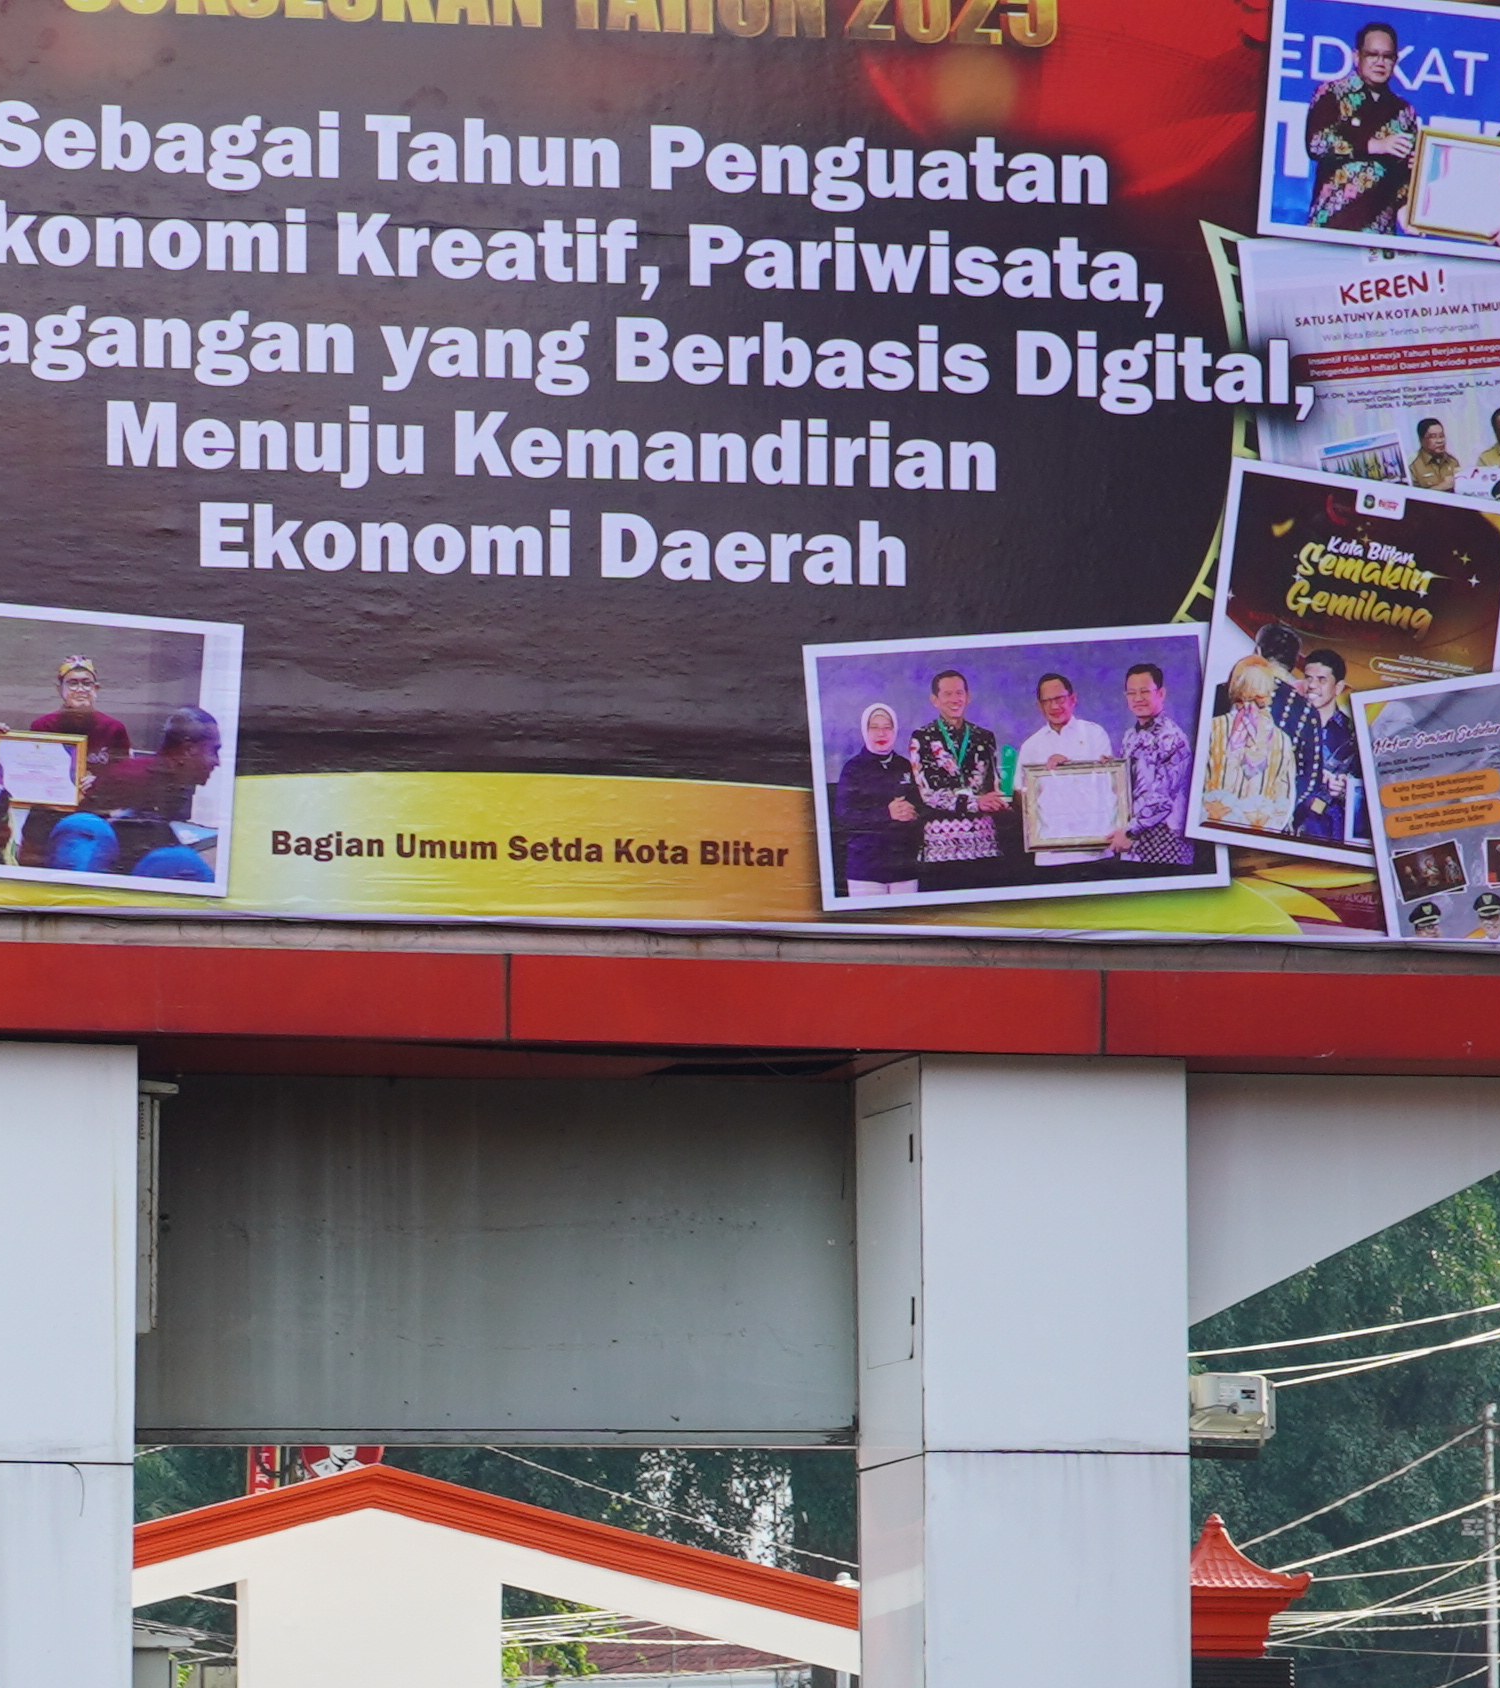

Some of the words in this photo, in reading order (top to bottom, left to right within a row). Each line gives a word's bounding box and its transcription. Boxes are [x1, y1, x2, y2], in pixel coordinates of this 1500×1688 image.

[1281, 33, 1489, 96] EDKAT
[365, 114, 620, 188] Tahun
[650, 124, 1108, 213] Penguatan
[337, 211, 659, 301] Kreatif,
[688, 224, 1164, 319] Pariwisata,
[1340, 270, 1428, 306] KEREN
[1295, 316, 1325, 327] SATU
[1328, 312, 1383, 325] SATUNYA
[1385, 308, 1420, 320] KOTA
[1421, 307, 1432, 316] DI
[1435, 304, 1469, 316] JAWA
[1344, 331, 1363, 341] Kota
[1365, 329, 1388, 339] Blitar
[1390, 326, 1420, 337] Terima
[1422, 323, 1479, 336] Penghargaan
[380, 320, 590, 396] yang
[616, 316, 990, 394] Berbasis
[1017, 330, 1313, 420] Digital,
[1308, 355, 1341, 365] Insentif
[1343, 353, 1368, 363] Fiskal
[1370, 351, 1400, 362] Kinerja
[1402, 348, 1430, 358] Tahun
[1310, 364, 1369, 378] Pengendalian
[1400, 359, 1430, 370] Daerah
[1433, 356, 1466, 367] Periode
[106, 400, 424, 489] Menuju
[454, 410, 997, 491] Kemandirian
[199, 501, 570, 577] Ekonomi
[601, 512, 906, 586] Daerah
[1296, 542, 1432, 592] Semakin
[1327, 536, 1363, 558] Kota
[1286, 579, 1433, 642] Gemilang
[271, 830, 385, 862] Bagian
[395, 833, 498, 861] Umum
[507, 835, 604, 863] Setda
[613, 838, 690, 865] Kota
[700, 840, 790, 868] Blitar
